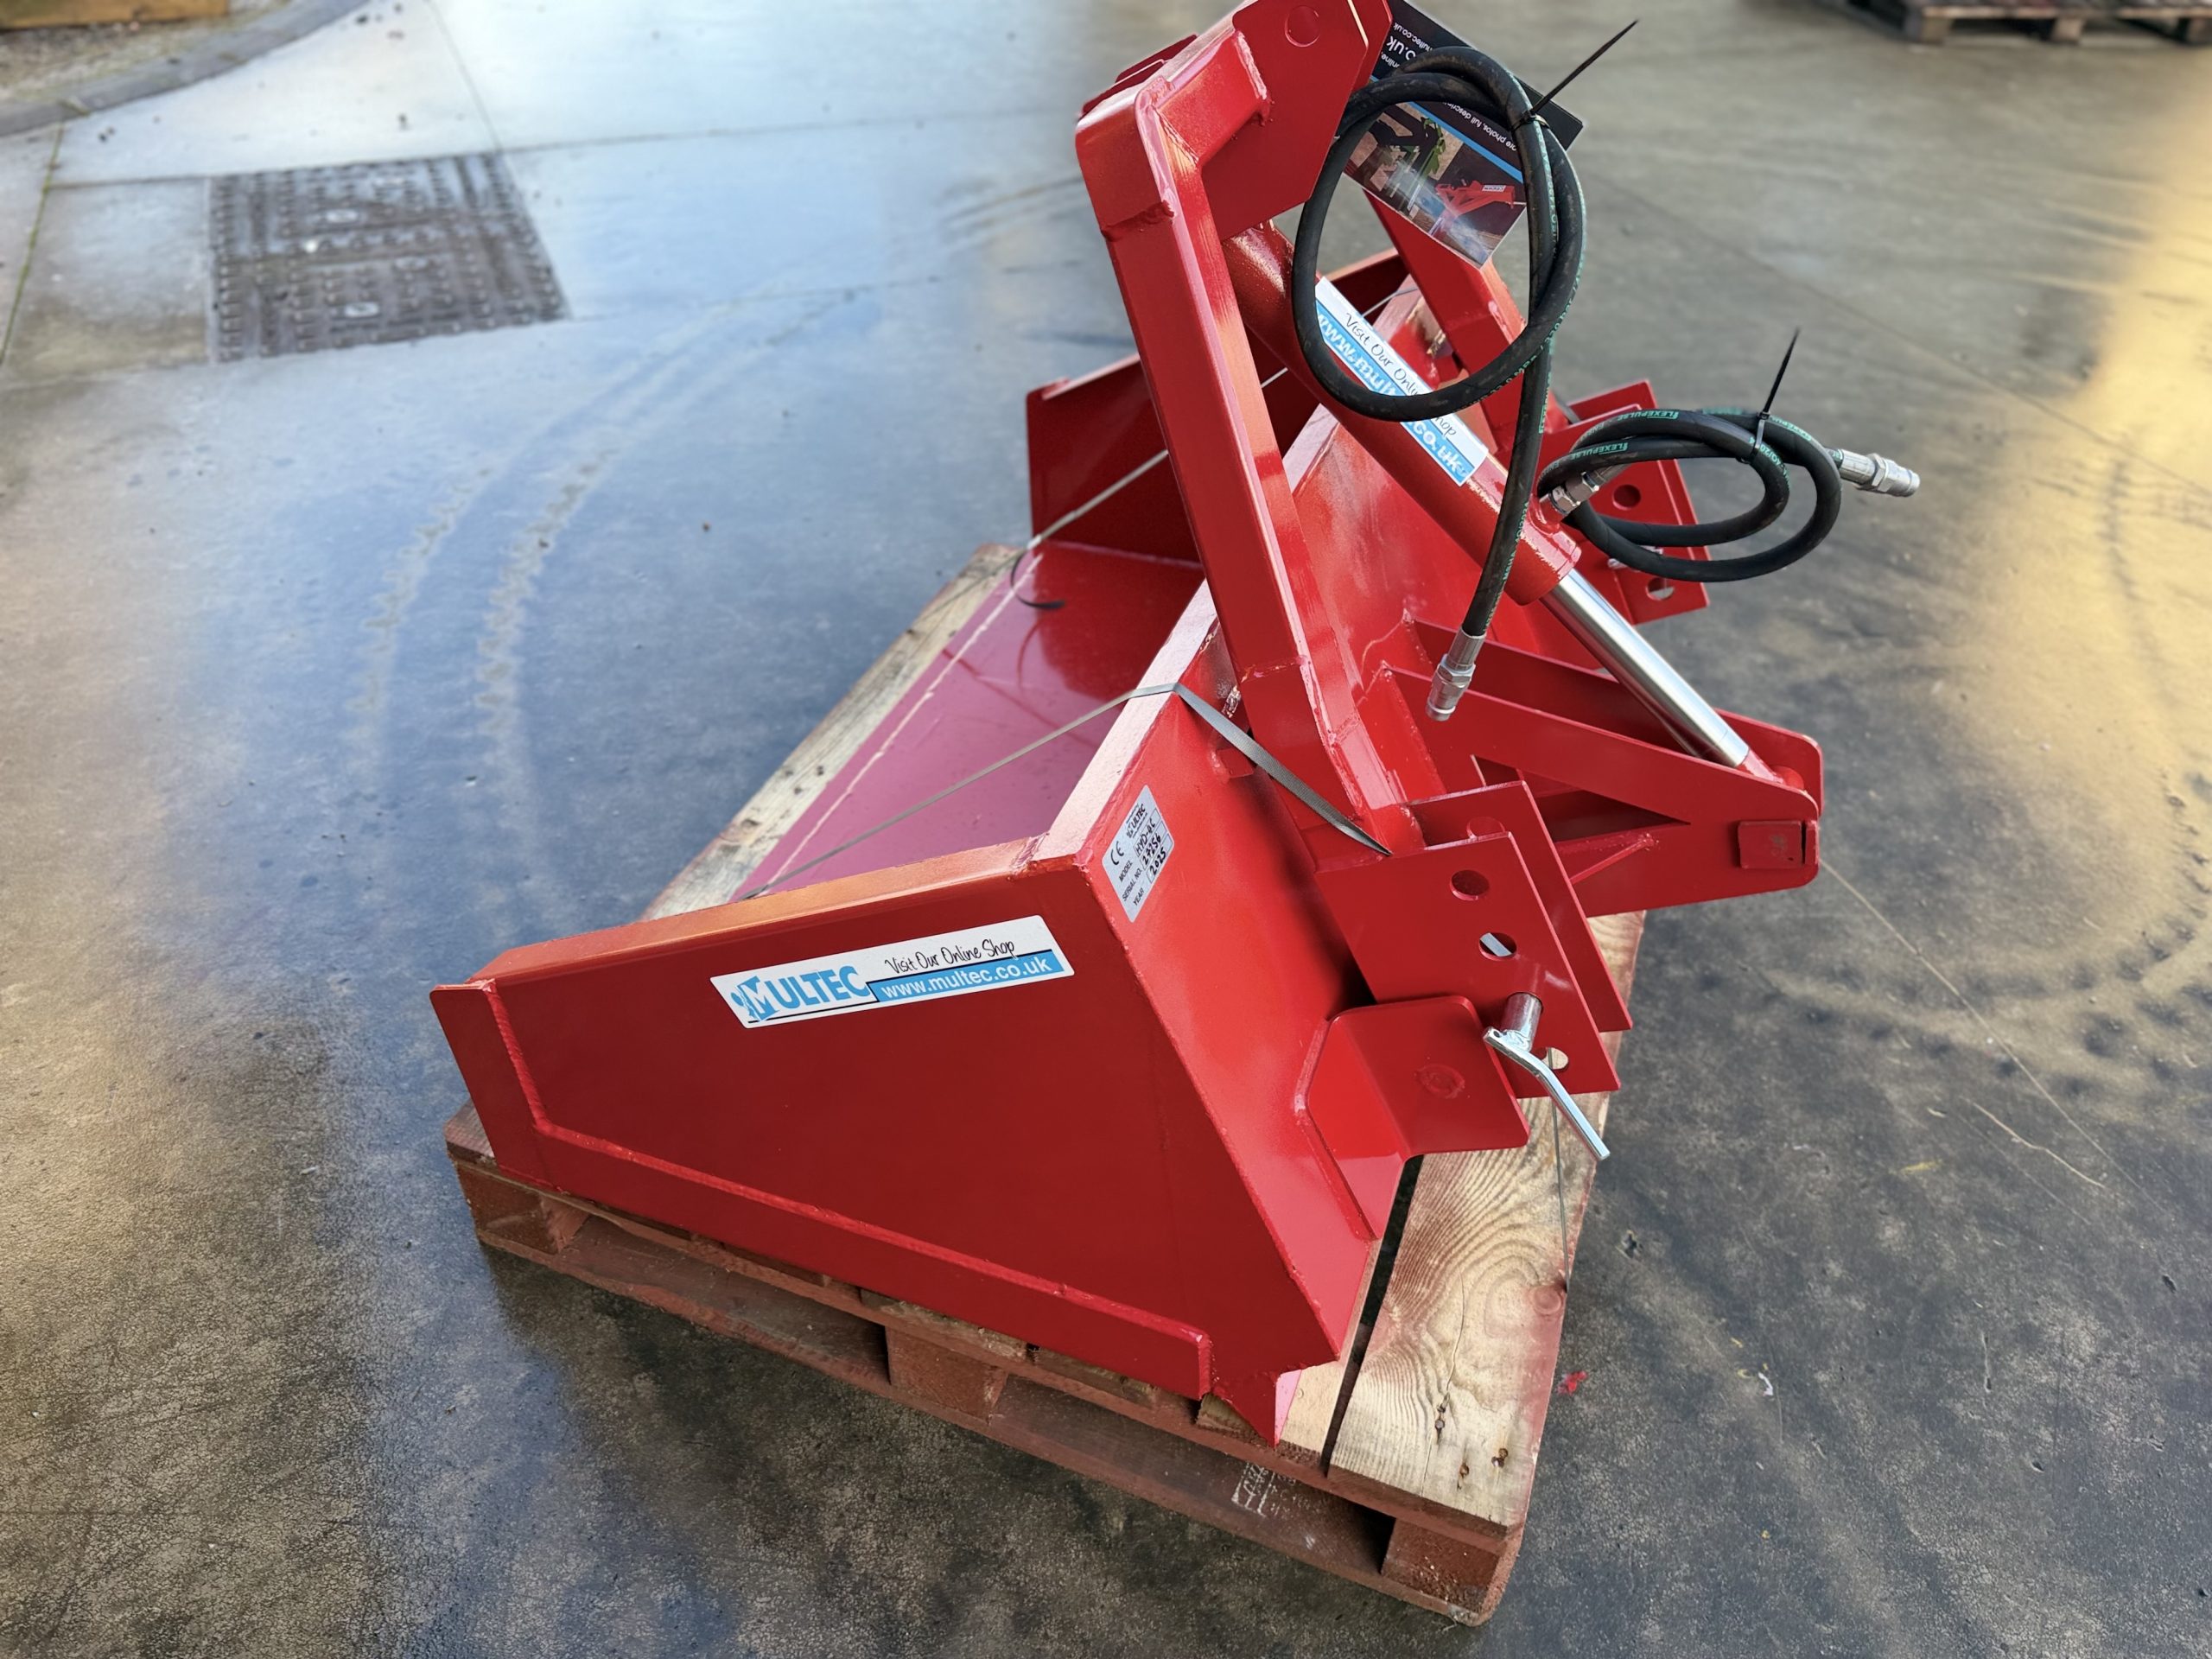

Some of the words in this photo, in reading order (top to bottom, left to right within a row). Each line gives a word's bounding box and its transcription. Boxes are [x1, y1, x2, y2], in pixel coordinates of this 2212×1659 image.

[1470, 116, 1482, 129] full
[1483, 123, 1507, 143] photos,
[1346, 312, 1371, 346] Visit
[1370, 343, 1392, 367] Our
[1571, 442, 1629, 461] FLEXEPULSE
[1118, 860, 1133, 882] MODEL
[1133, 887, 1144, 906] YEAR
[1149, 847, 1166, 875] 2025
[1122, 878, 1136, 901] SERIAL
[885, 957, 918, 975] Visit
[915, 951, 940, 969] Our
[940, 944, 982, 965] Online
[982, 938, 1017, 960] Shop
[731, 965, 871, 1020] MULTEC
[880, 957, 1053, 999] www.multec.co.uk
